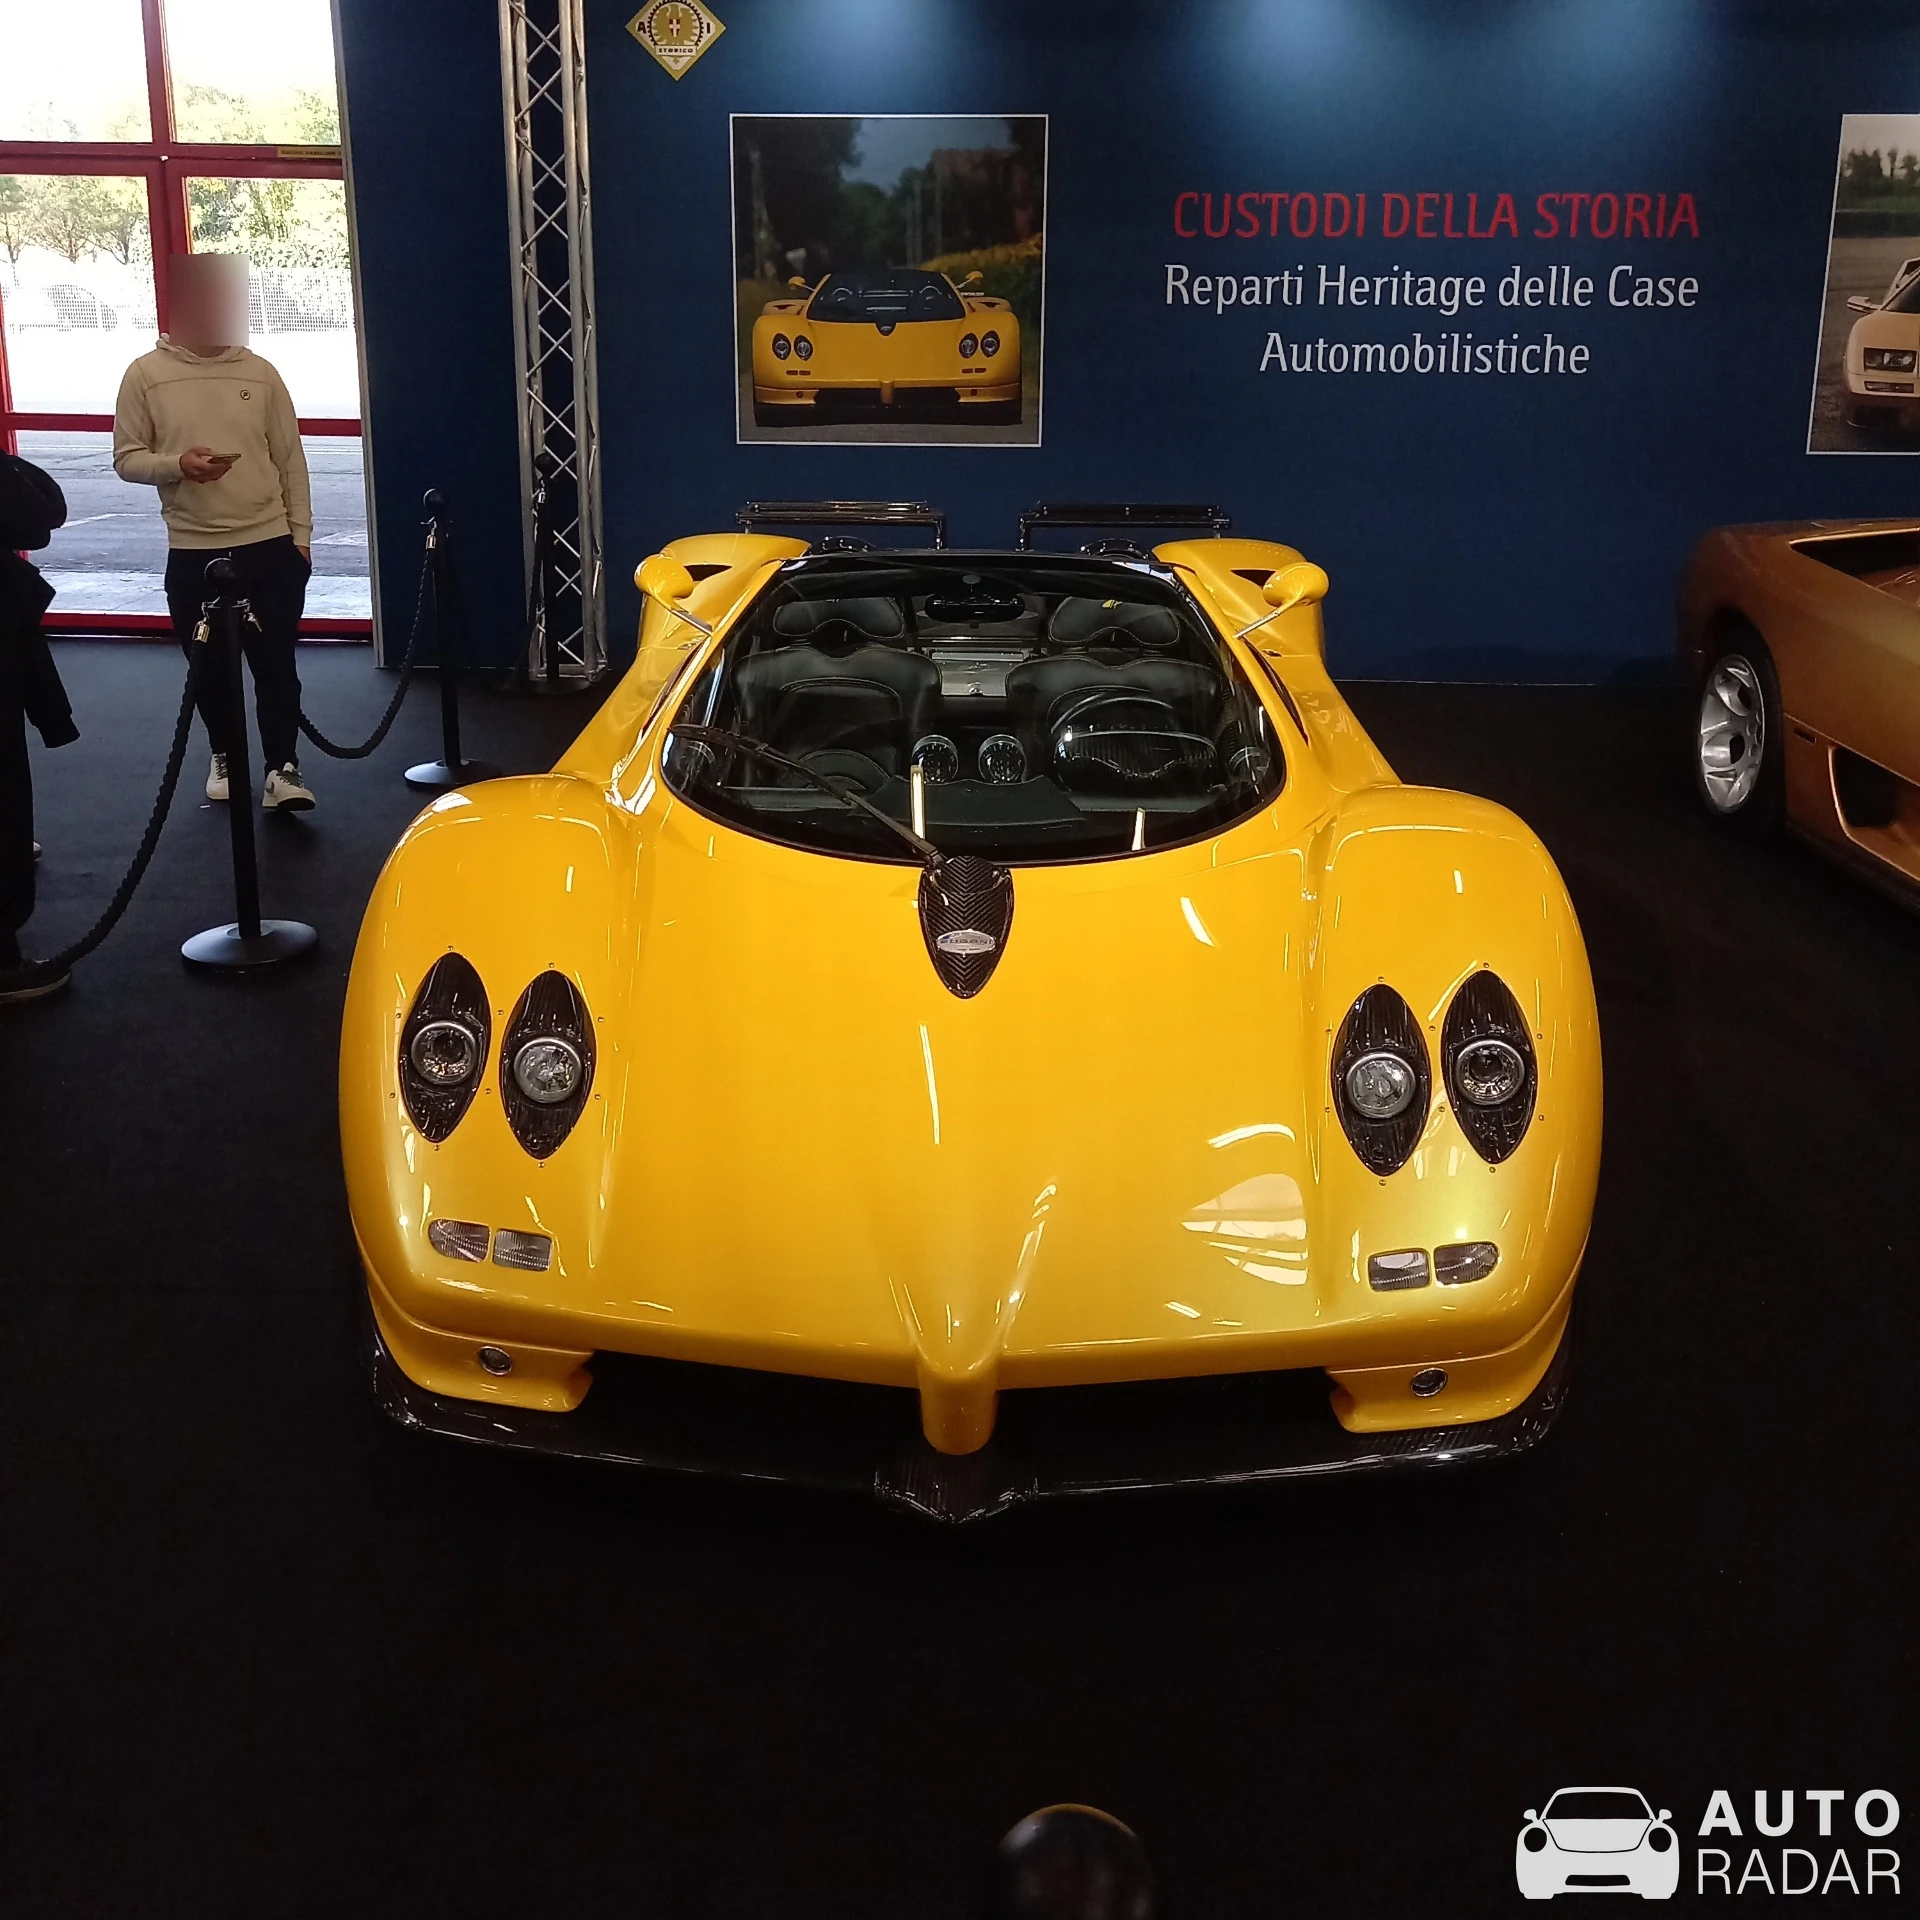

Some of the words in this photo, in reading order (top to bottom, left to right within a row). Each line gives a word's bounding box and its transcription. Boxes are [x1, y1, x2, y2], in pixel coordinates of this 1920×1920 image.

[1174, 192, 1366, 238] CUSTODI
[1383, 193, 1519, 238] DELLA
[1535, 193, 1699, 239] STORIA
[1164, 264, 1304, 315] Reparti
[1317, 264, 1486, 316] Heritage
[1498, 265, 1594, 307] delle
[1608, 265, 1699, 307] Case
[1259, 332, 1590, 374] Automobilistiche
